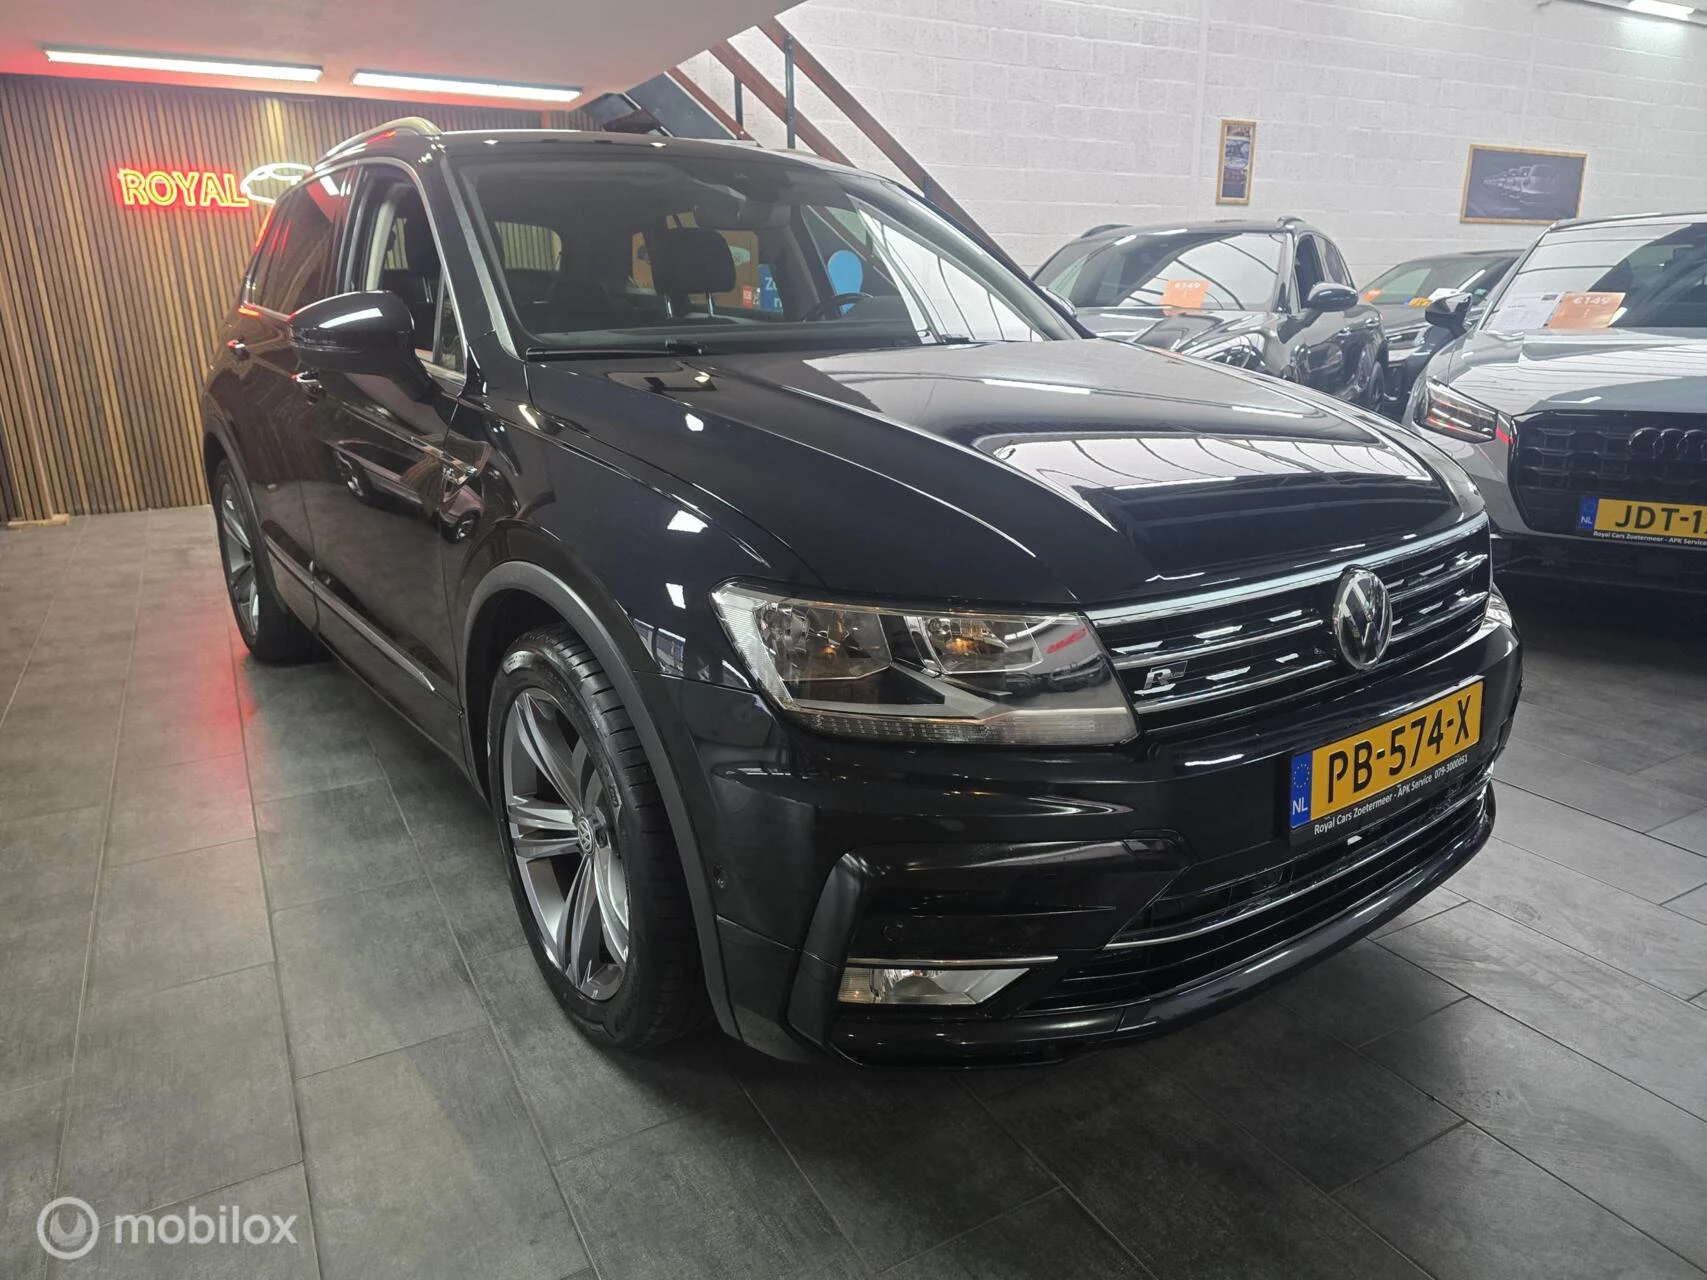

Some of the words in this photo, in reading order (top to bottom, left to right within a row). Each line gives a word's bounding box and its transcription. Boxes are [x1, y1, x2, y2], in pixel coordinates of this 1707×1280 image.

[120, 168, 249, 208] ROYAL
[1580, 516, 1593, 525] NL
[1615, 504, 1707, 535] JDT-1
[1626, 534, 1663, 542] Zoetermeer
[1683, 538, 1707, 546] Service
[1328, 695, 1472, 804] PB-574-X
[1292, 797, 1308, 816] NL
[1314, 817, 1335, 835] Royal
[1337, 812, 1352, 825] Cars
[1353, 793, 1393, 818] Zoetermeer
[1398, 783, 1411, 798] APK
[1411, 775, 1432, 791] Service
